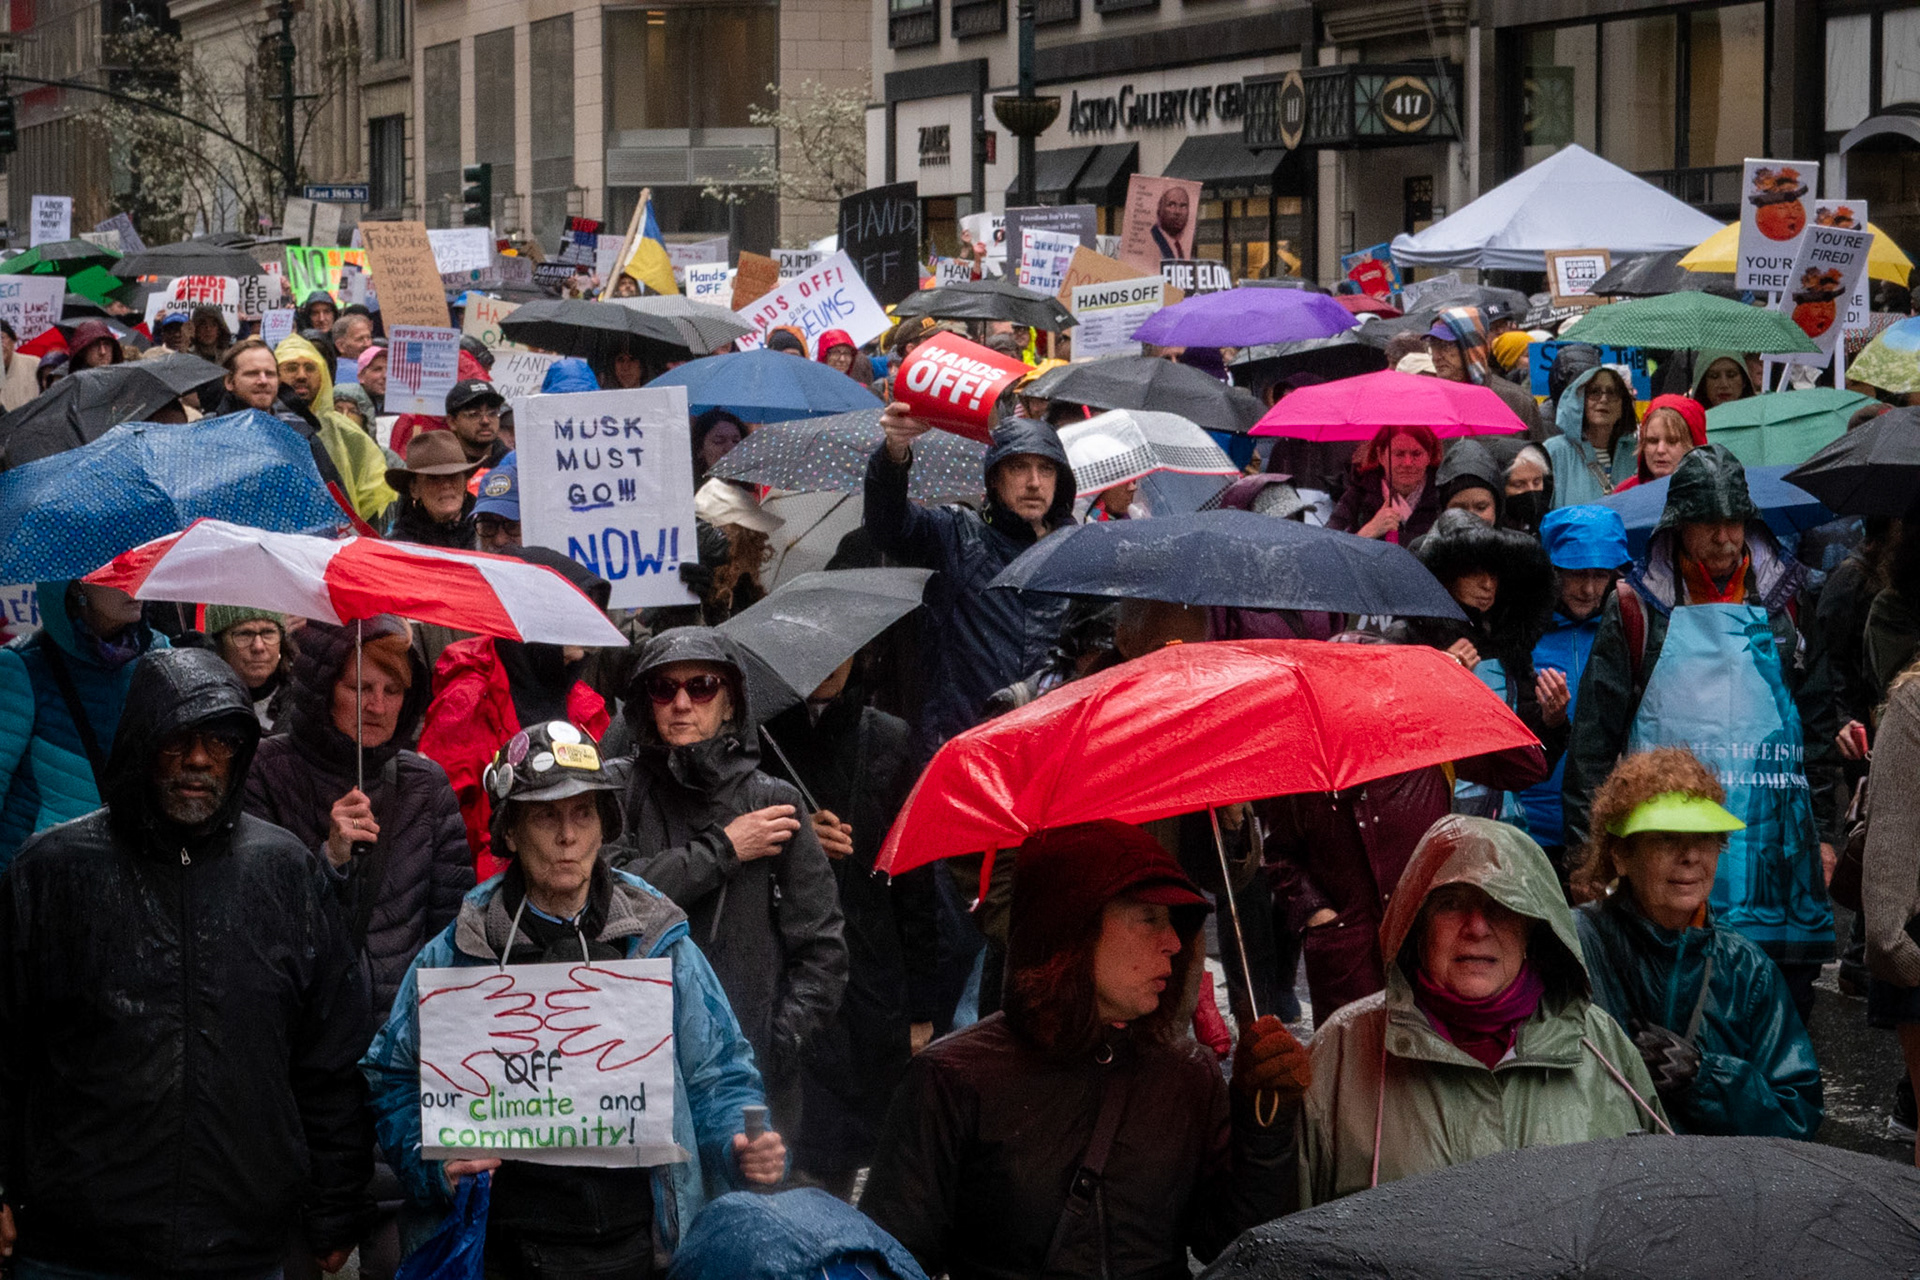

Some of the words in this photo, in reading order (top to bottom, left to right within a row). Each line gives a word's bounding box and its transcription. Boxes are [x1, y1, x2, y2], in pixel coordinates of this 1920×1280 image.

[1118, 85, 1189, 129] GALLERY
[1189, 86, 1213, 124] OF
[1392, 94, 1422, 115] 417
[309, 189, 330, 198] East
[353, 189, 364, 198] St
[40, 201, 63, 210] LABOR
[40, 211, 63, 220] PARTY
[1815, 232, 1864, 249] YOU'RE
[780, 253, 817, 268] DUMP
[1746, 256, 1793, 270] YOU'R
[1810, 249, 1854, 265] FIRED!
[290, 249, 327, 289] NO
[536, 265, 575, 277] AGAINST
[690, 270, 727, 282] Hands
[863, 250, 900, 285] FF
[177, 274, 227, 291] HANDS
[798, 267, 844, 298] OFF!
[1163, 265, 1195, 290] FIRE
[1197, 264, 1232, 290] ELON
[1567, 280, 1594, 288] SCHOOL
[696, 283, 721, 294] OFF
[1078, 290, 1128, 308] HANDS
[1132, 286, 1159, 302] OFF
[167, 301, 188, 310] OUR
[789, 303, 808, 319] OUR
[24, 315, 55, 325] PEOPLE
[394, 330, 434, 340] SPEAK
[437, 332, 454, 341] UP
[922, 346, 1007, 380] HANDS
[499, 384, 525, 398] OUR
[906, 360, 992, 411] OFF!
[554, 415, 643, 440] MUSK
[556, 447, 644, 471] MUST
[567, 478, 636, 505] GO!!!
[568, 527, 679, 580] NOW!
[495, 1048, 562, 1090] OFF
[421, 1091, 463, 1108] our
[469, 1085, 575, 1122] climate
[600, 1082, 646, 1111] and
[438, 1117, 635, 1148] community!
